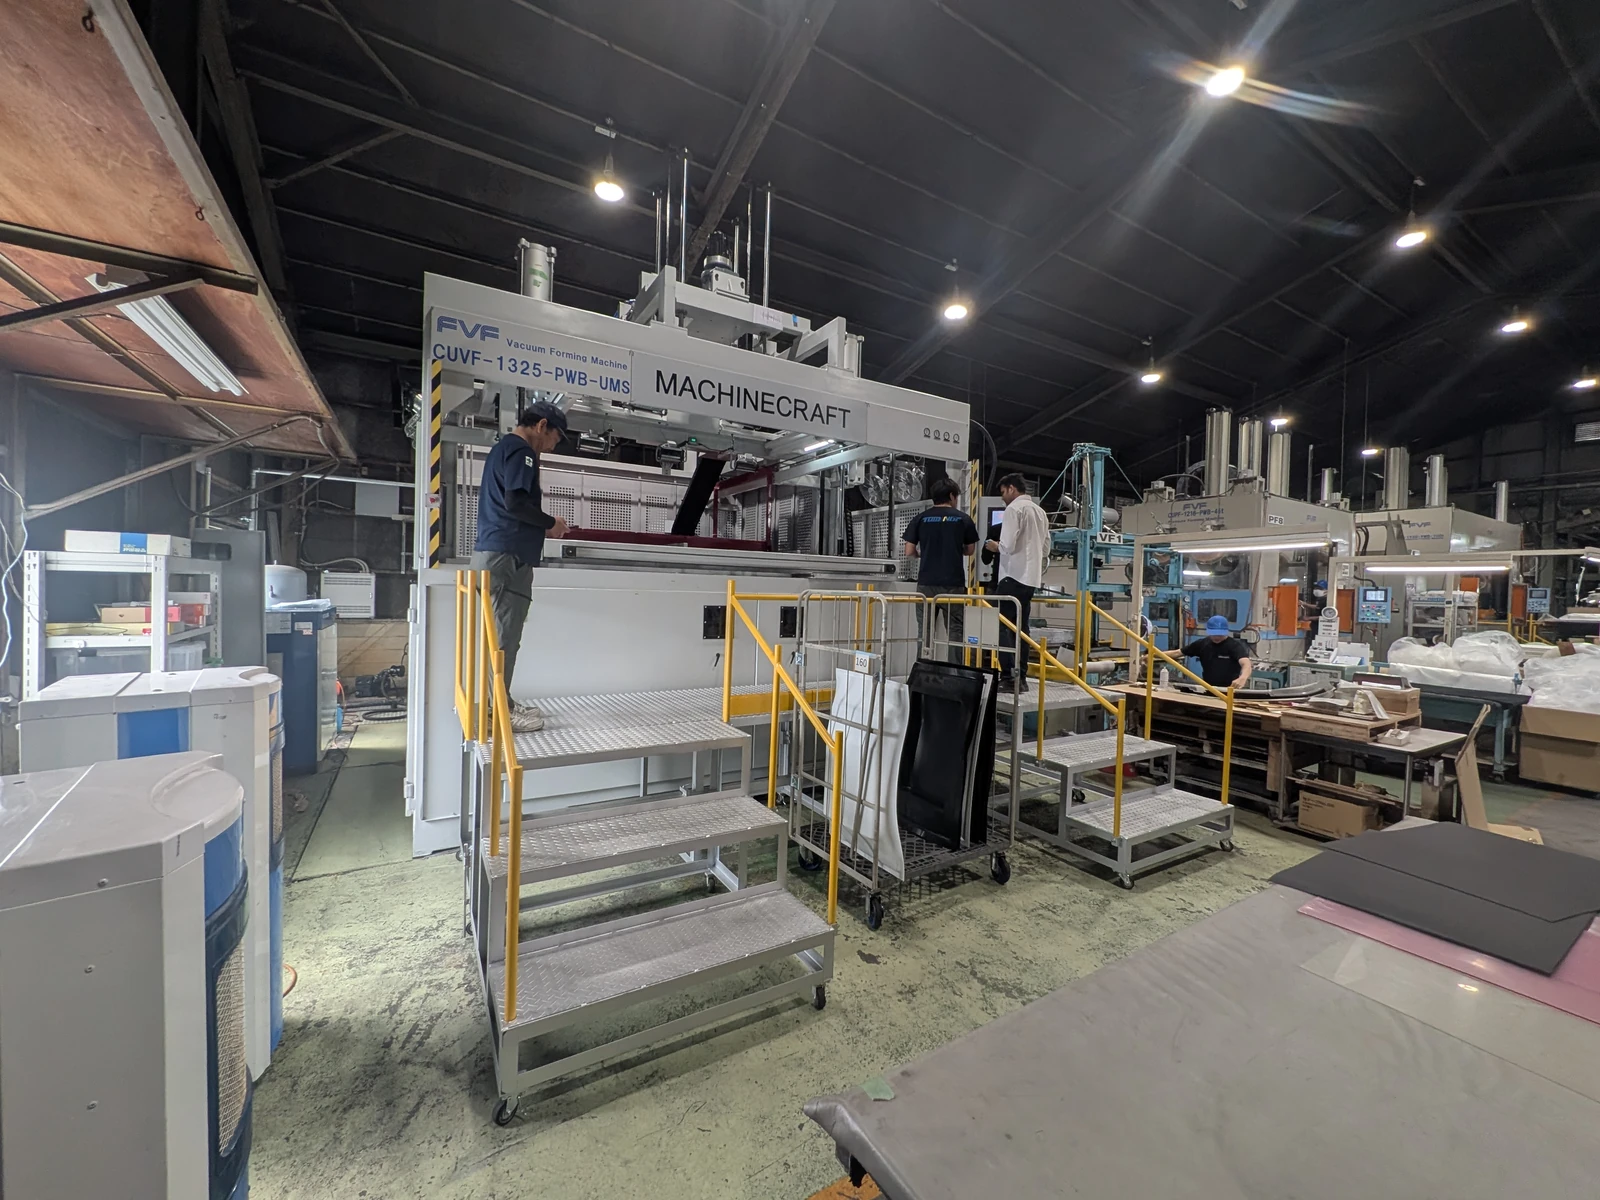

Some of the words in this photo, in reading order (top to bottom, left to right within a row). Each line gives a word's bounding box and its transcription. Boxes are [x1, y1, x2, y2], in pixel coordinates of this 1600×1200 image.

[436, 315, 500, 341] FVF
[506, 338, 546, 354] Vacuum
[549, 347, 588, 363] Forming
[590, 356, 628, 371] Machine
[433, 343, 631, 395] CUVF-1325-PWB-UMS
[655, 369, 851, 429] MACHINECRAFT
[1268, 515, 1283, 525] PF8
[1099, 533, 1122, 543] VF1
[855, 657, 868, 668] 160
